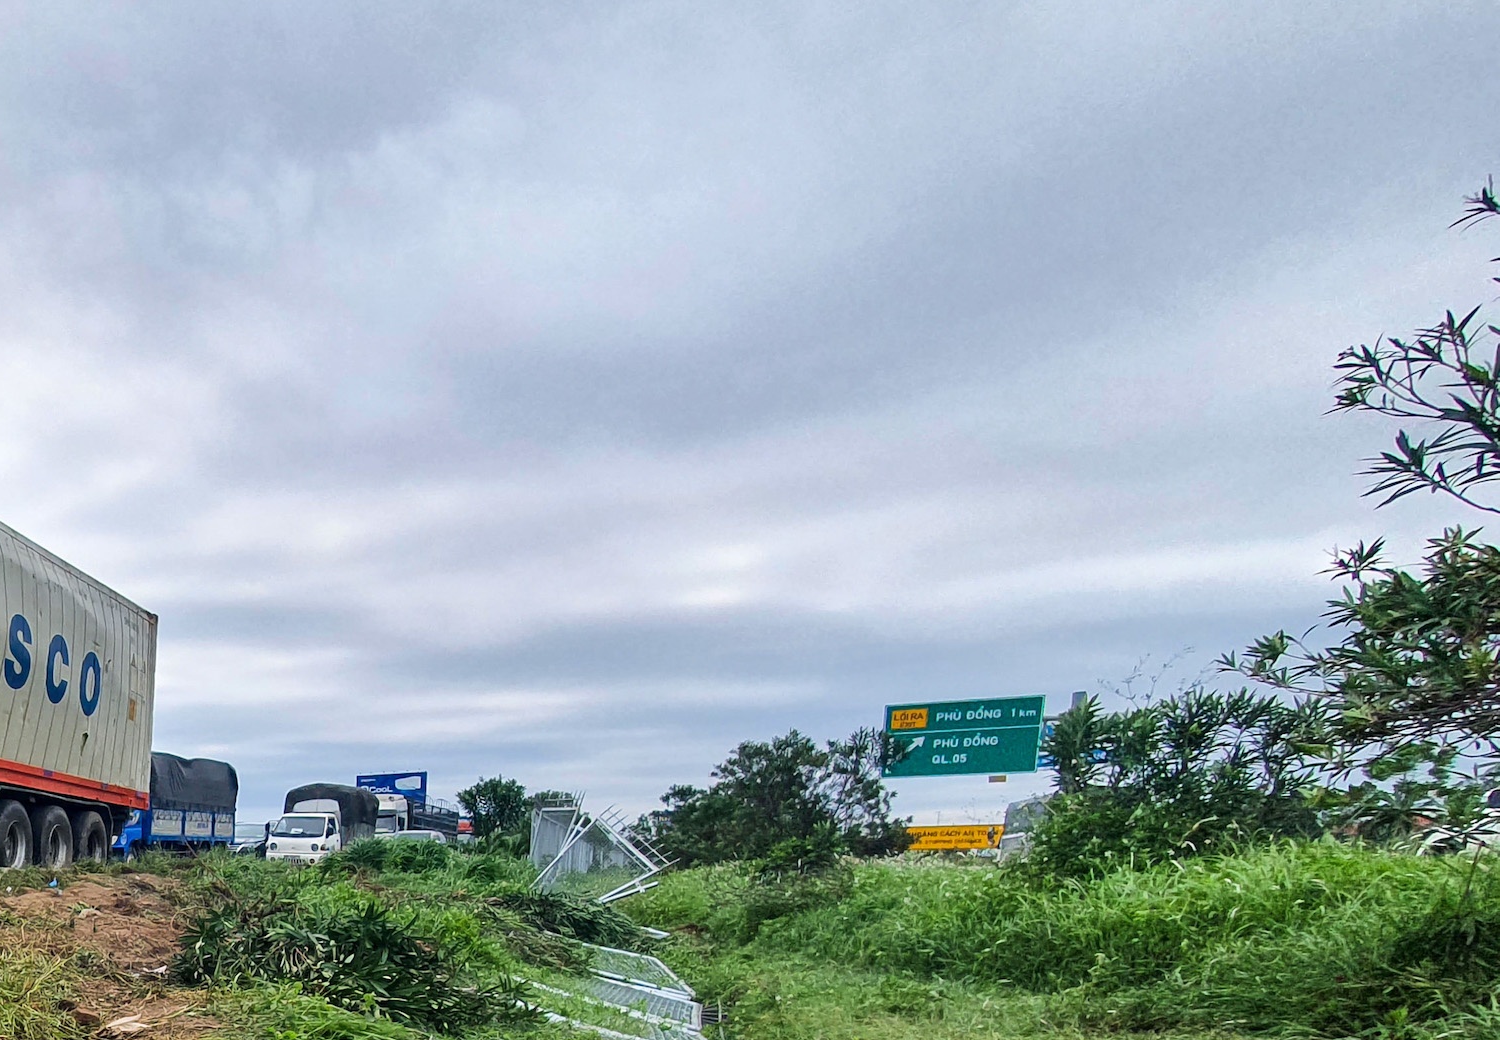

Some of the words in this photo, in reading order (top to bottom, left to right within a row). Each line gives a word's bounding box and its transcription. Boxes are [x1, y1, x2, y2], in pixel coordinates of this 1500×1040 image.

[910, 712, 924, 721] RA
[1011, 708, 1017, 717] 1
[1019, 709, 1037, 717] km
